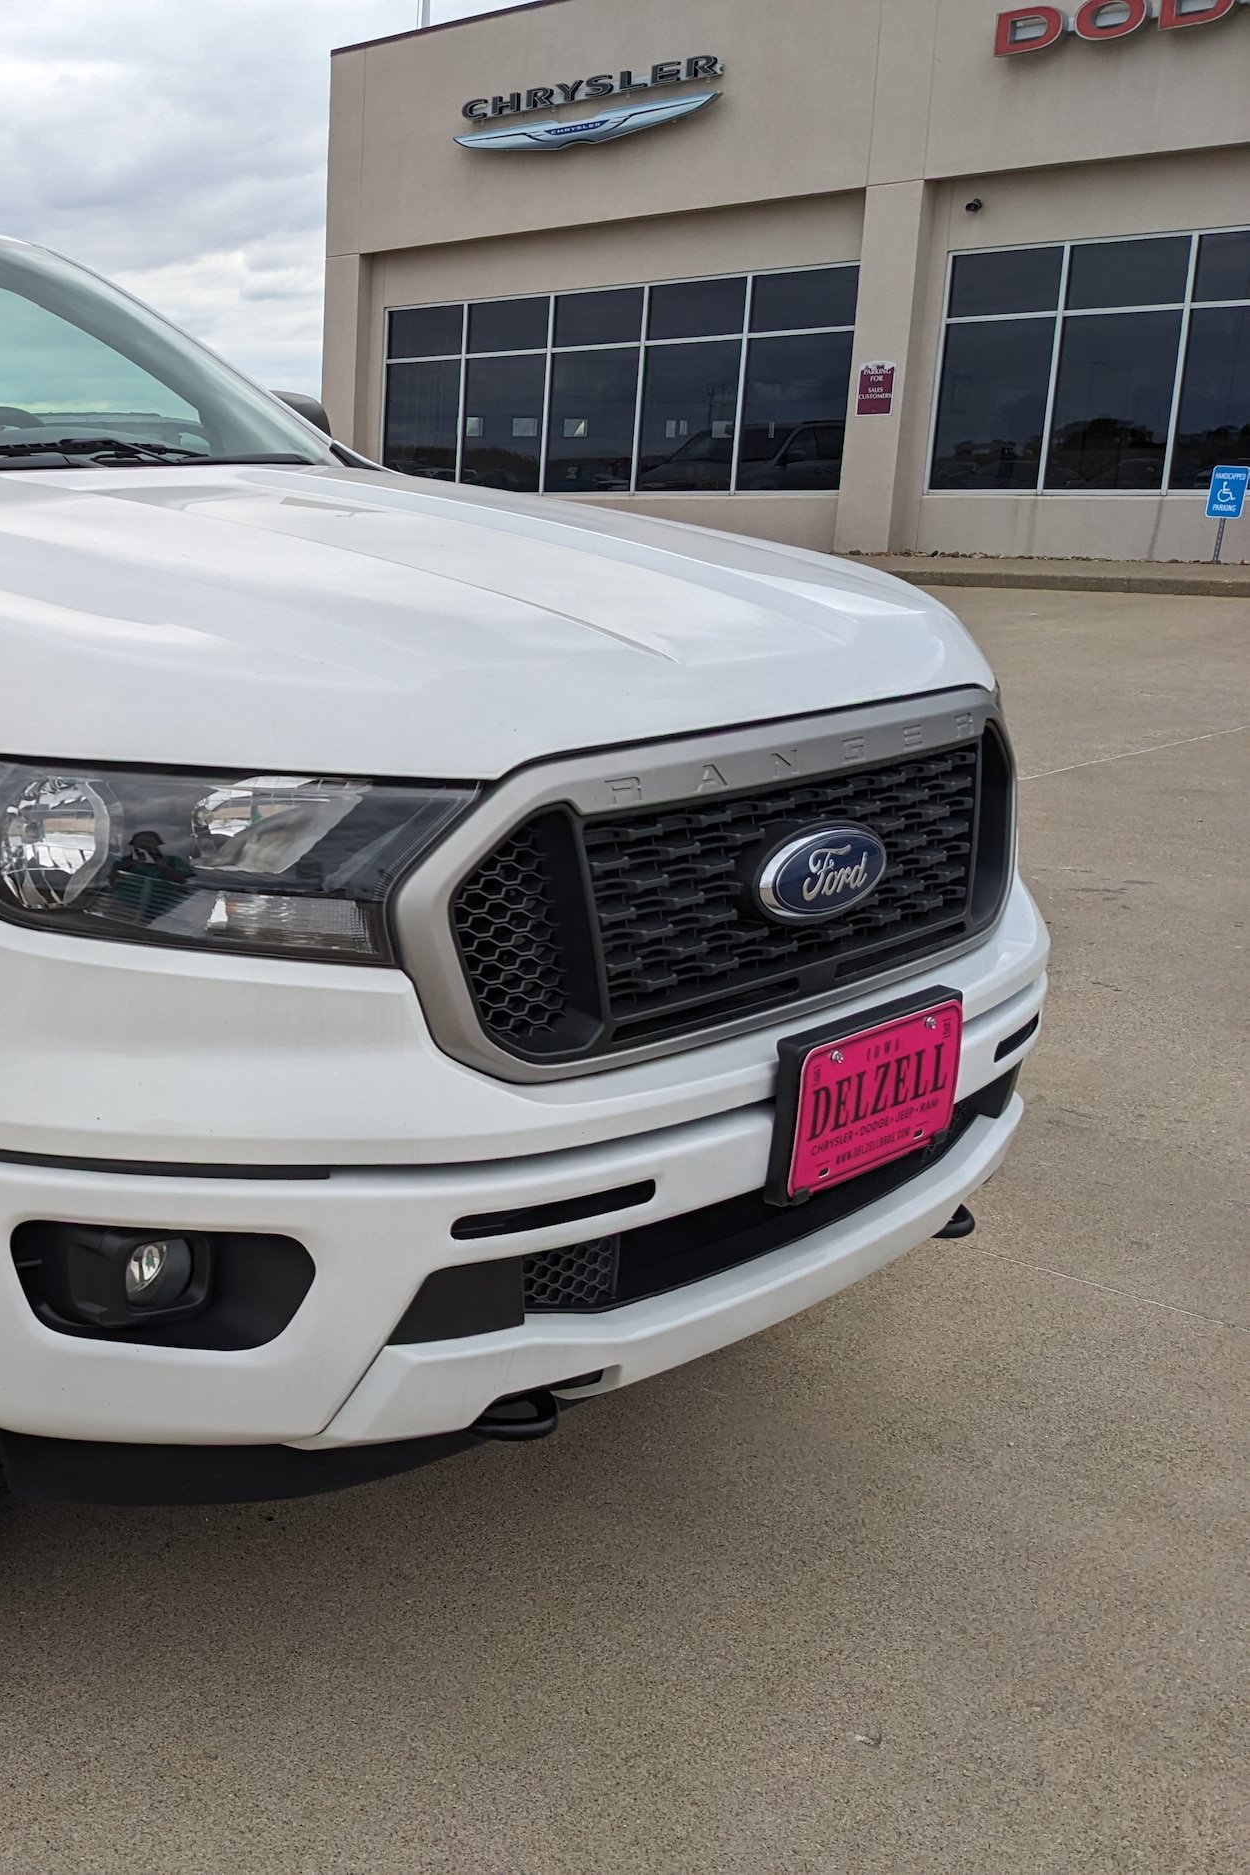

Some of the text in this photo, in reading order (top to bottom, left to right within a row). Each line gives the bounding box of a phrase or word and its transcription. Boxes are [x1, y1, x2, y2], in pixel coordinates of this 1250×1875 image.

[461, 54, 720, 120] CHRYSLER
[550, 121, 602, 135] CHRYSLER
[1215, 472, 1246, 480] HANDICAPPED
[1212, 503, 1237, 512] PARKING
[603, 711, 976, 807] RANGER
[802, 842, 869, 902] Ford
[866, 1038, 901, 1062] IOWA
[808, 1043, 947, 1141] DELZELL
[810, 1099, 939, 1156] CHRYSLER DODGE JEEP RAM
